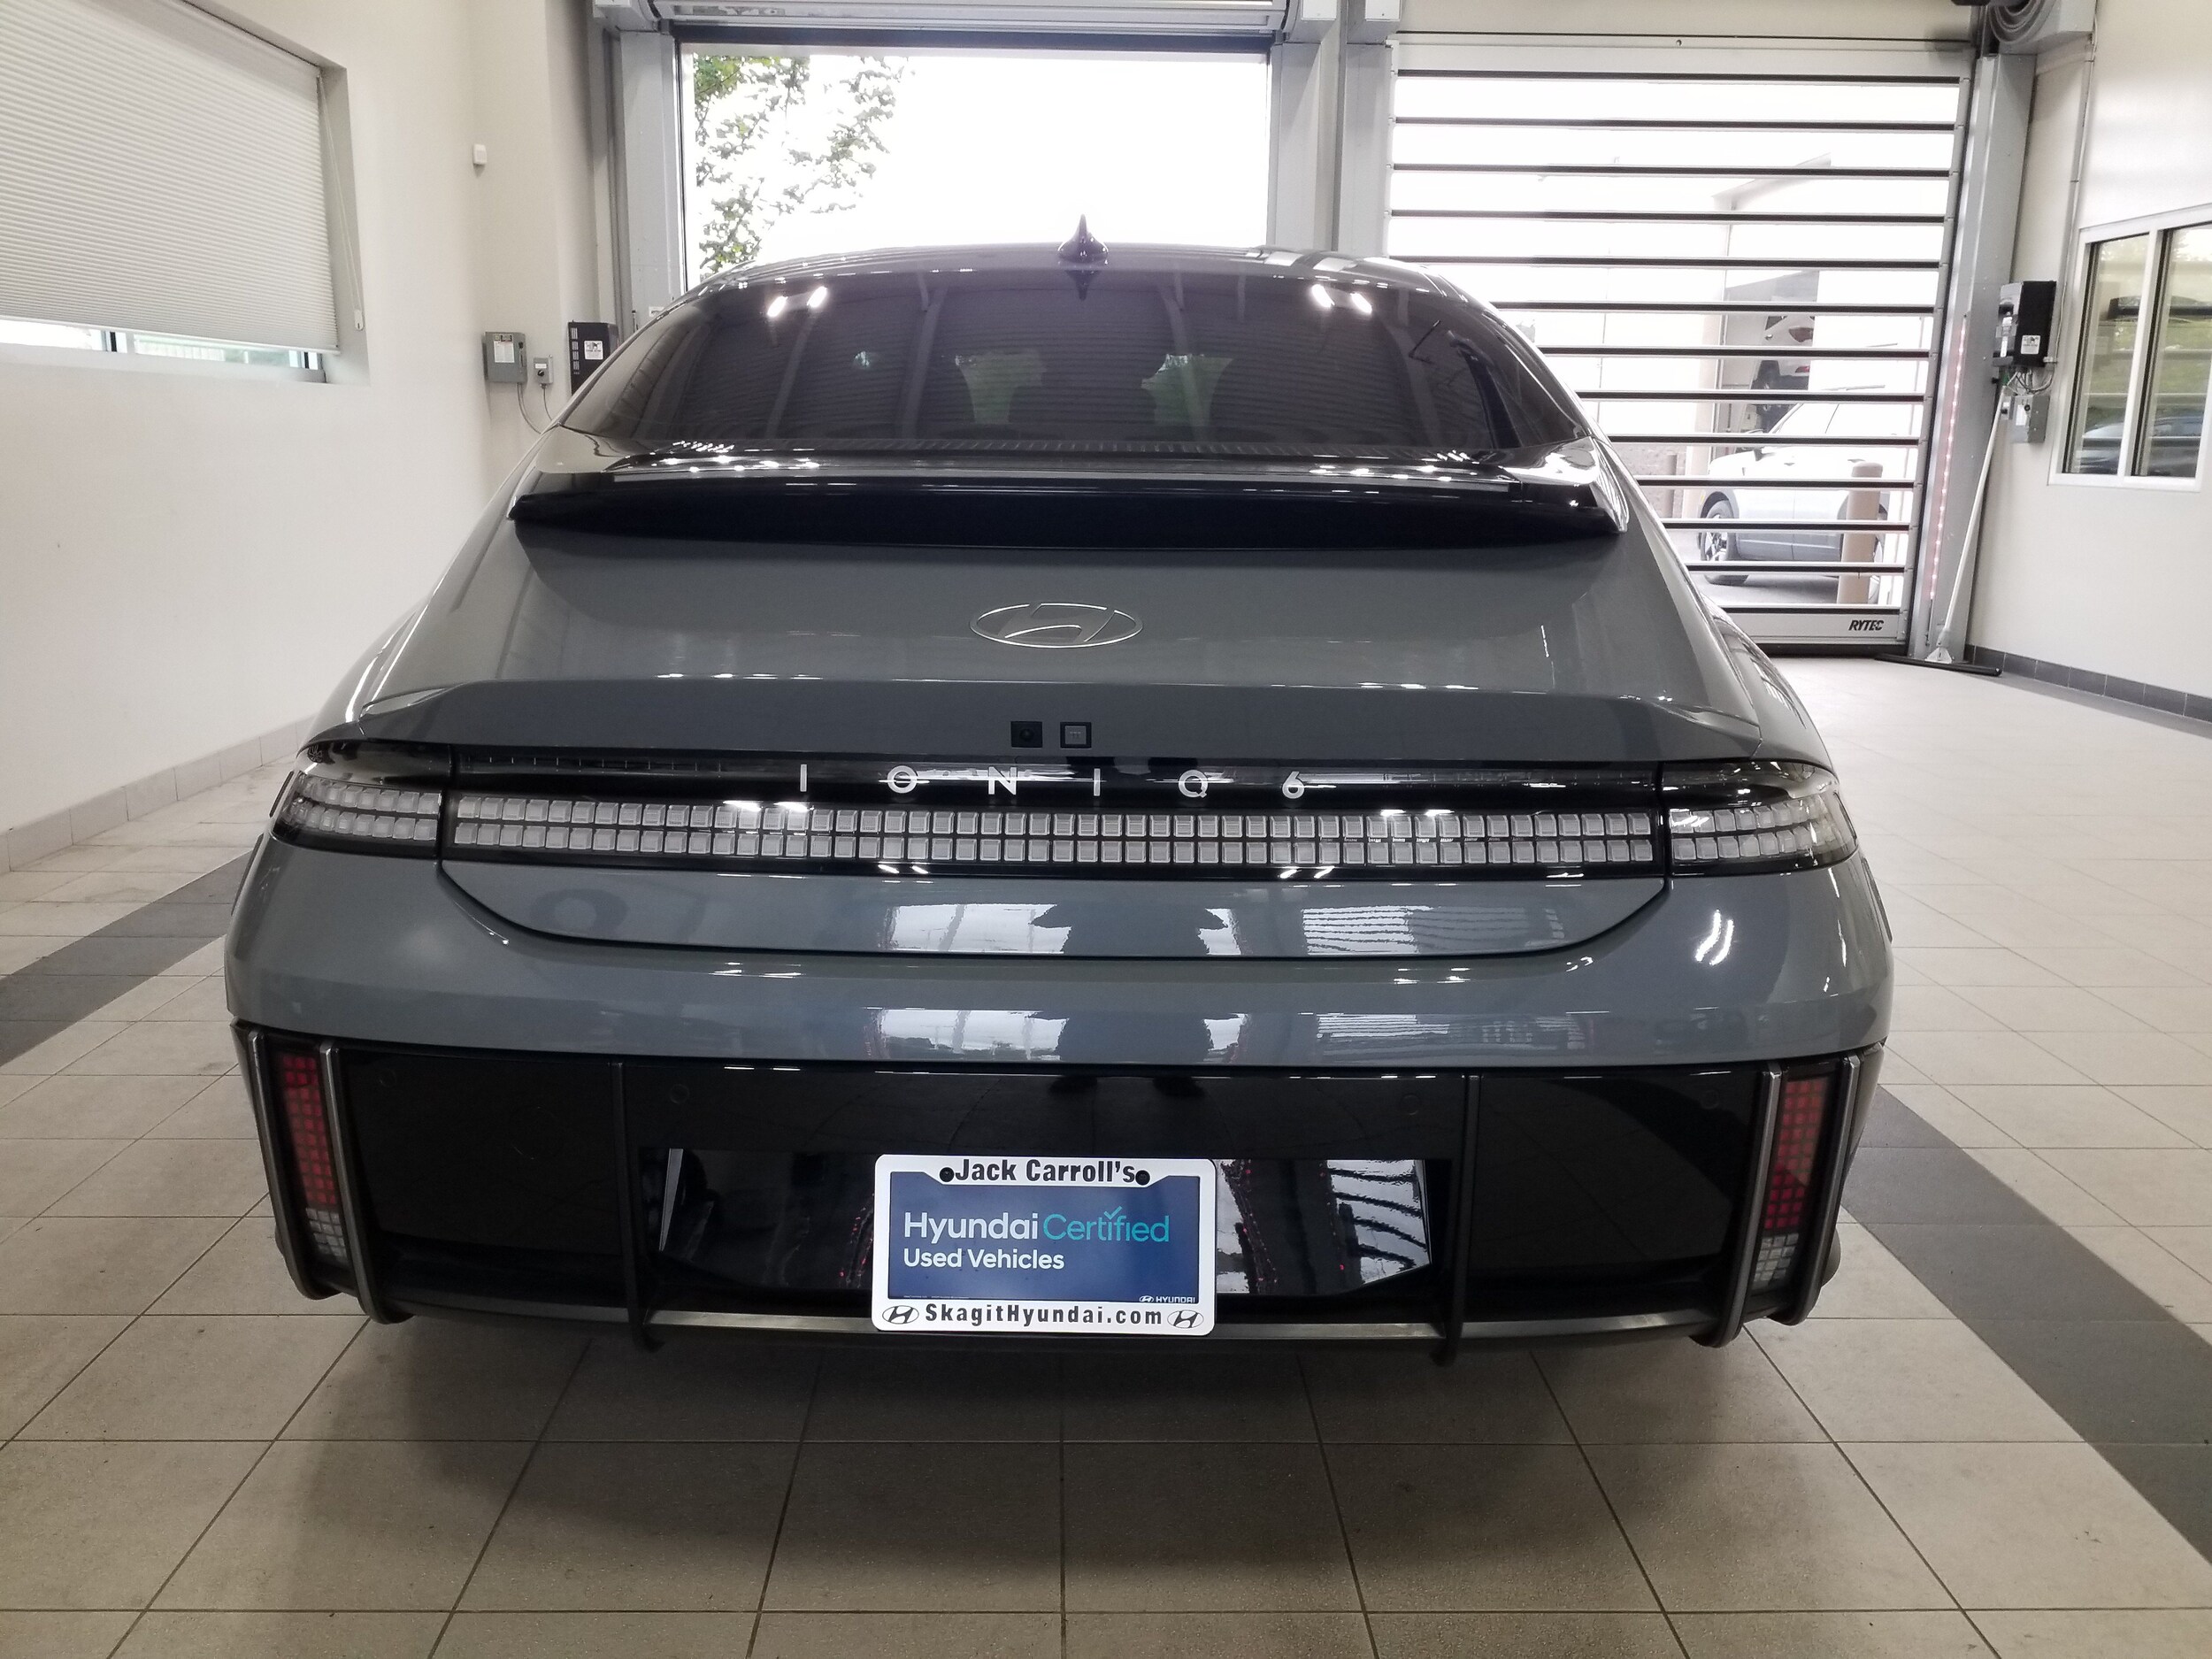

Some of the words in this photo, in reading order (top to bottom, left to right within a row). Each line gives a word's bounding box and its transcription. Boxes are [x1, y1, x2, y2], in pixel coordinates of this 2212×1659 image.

[1848, 619, 1884, 631] RYTEC
[955, 1158, 1017, 1182] Jack
[1025, 1159, 1135, 1184] Carroll's
[904, 1211, 1039, 1244] Hyundai
[1043, 1206, 1170, 1242] Certified
[903, 1248, 963, 1269] Used
[967, 1248, 1065, 1270] Vehicles
[926, 1302, 1163, 1326] SkagitHyundai.com
